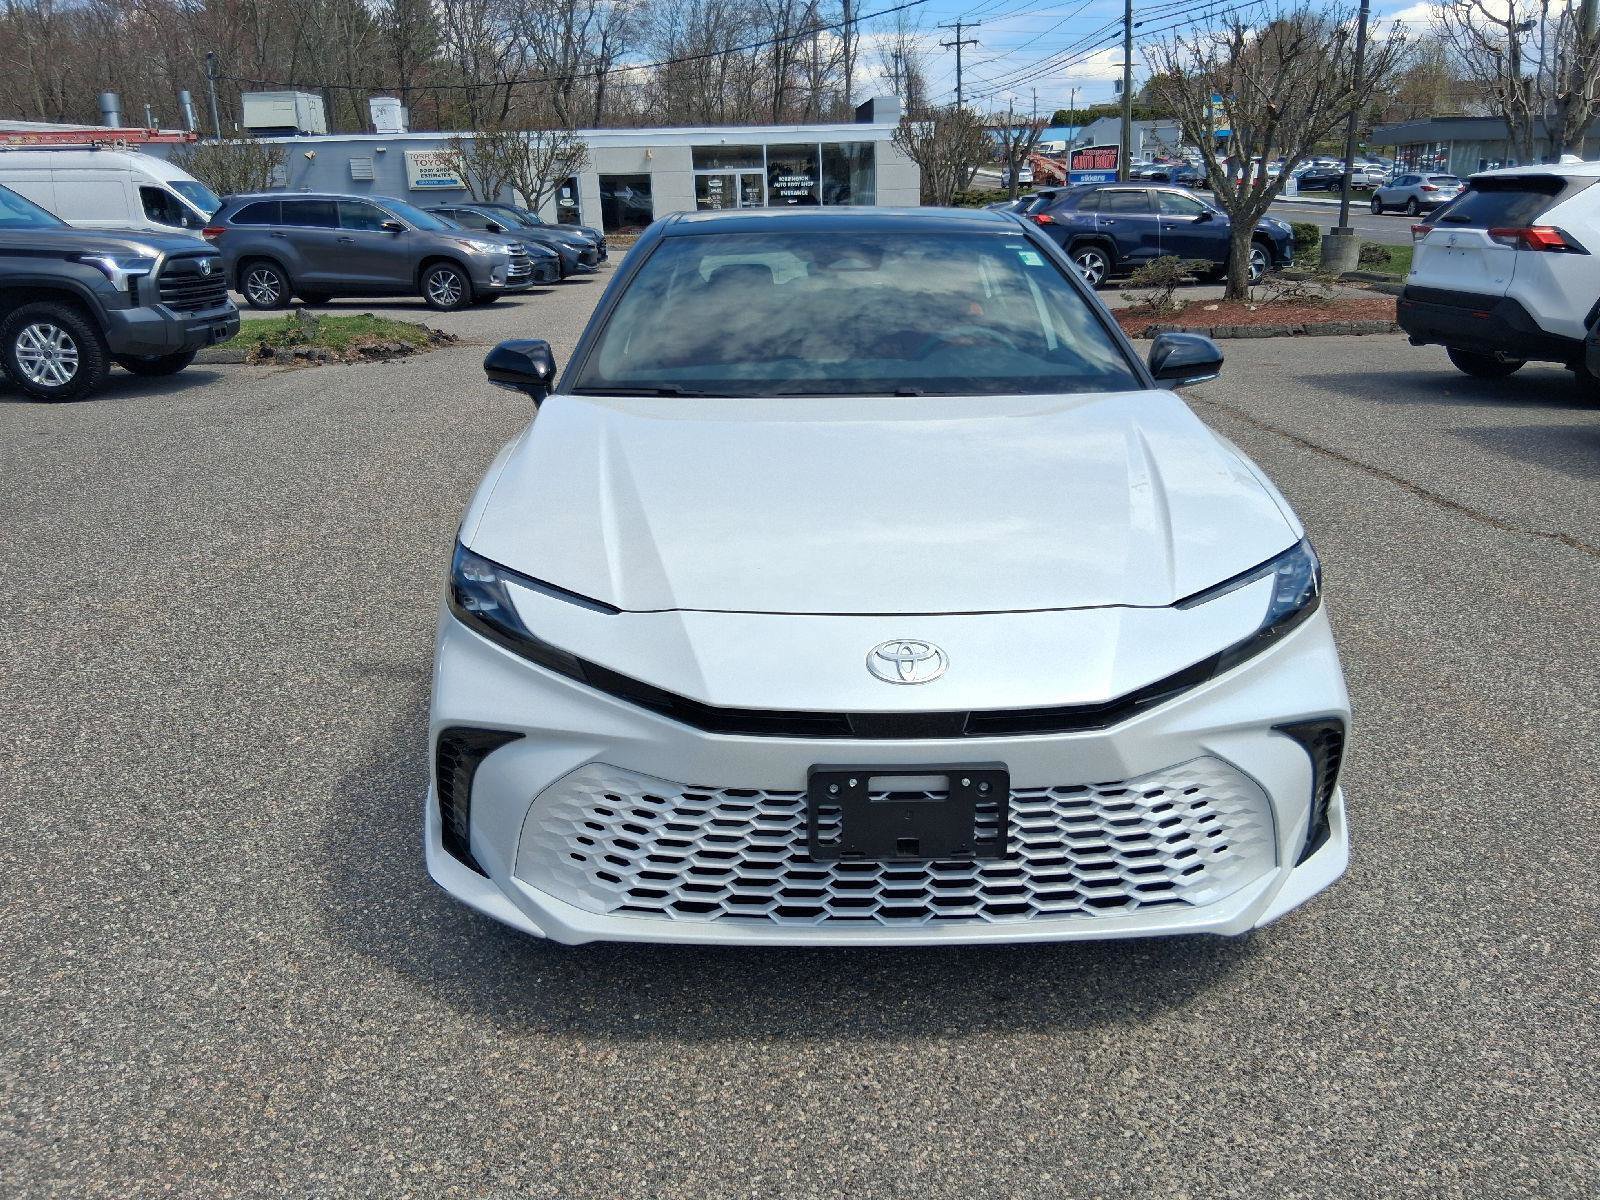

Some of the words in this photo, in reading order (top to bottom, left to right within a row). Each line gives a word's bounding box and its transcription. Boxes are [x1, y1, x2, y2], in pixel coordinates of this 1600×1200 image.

[1073, 155, 1094, 169] AUTO
[1095, 155, 1116, 169] BODY
[1080, 174, 1106, 182] sikkens
